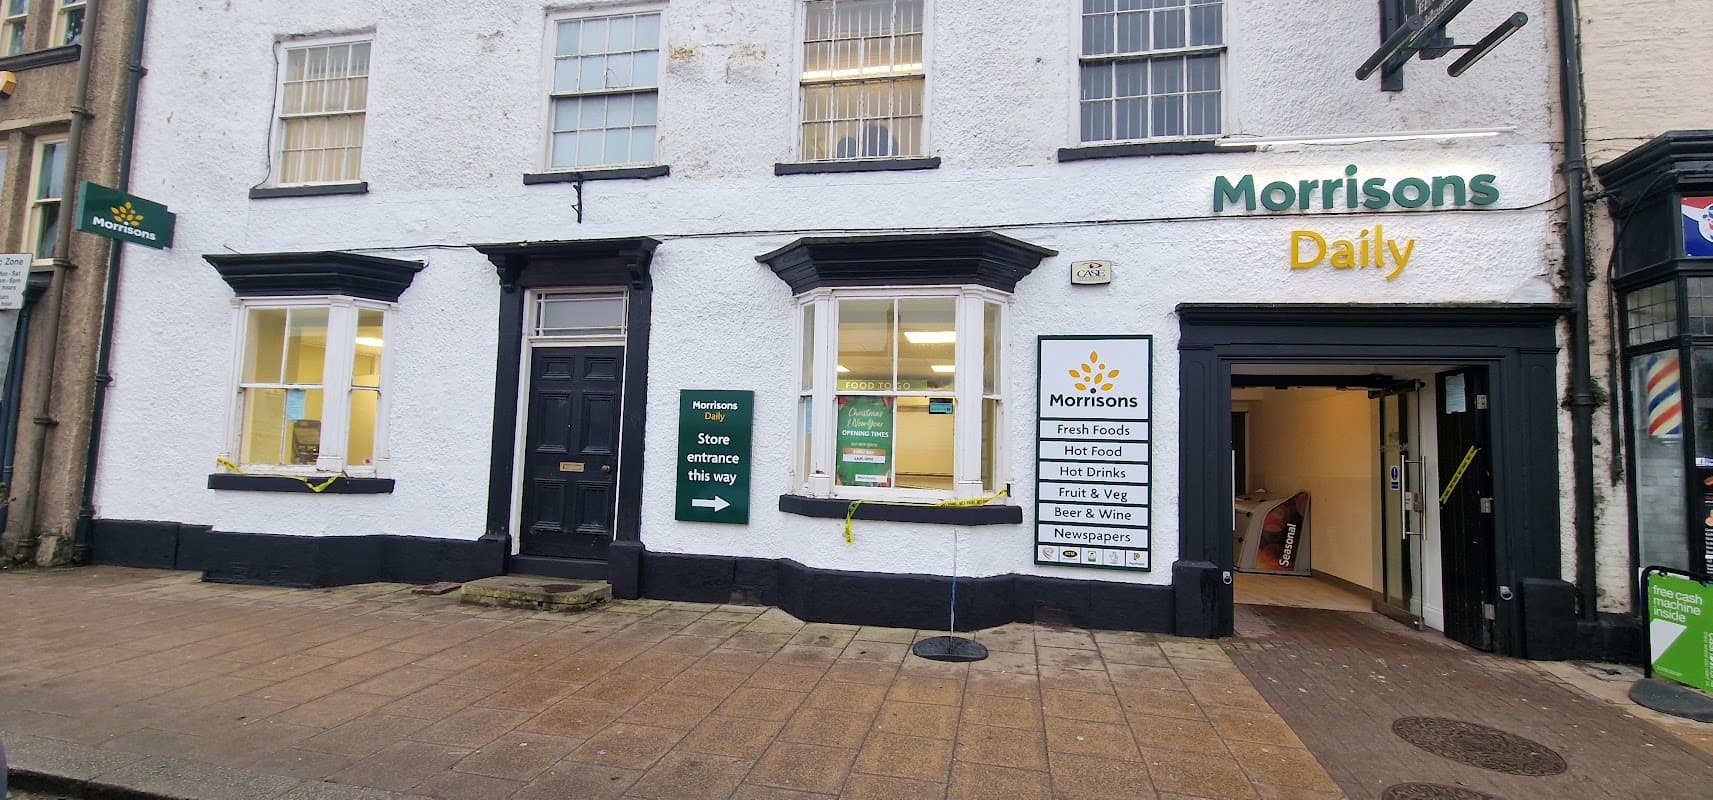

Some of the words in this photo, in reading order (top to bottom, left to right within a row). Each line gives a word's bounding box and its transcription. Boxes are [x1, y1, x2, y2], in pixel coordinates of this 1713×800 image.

[1213, 164, 1500, 212] Morrisons
[92, 216, 157, 241] Morrisons
[1290, 224, 1416, 281] Daily
[6, 257, 23, 266] Zone
[692, 401, 738, 410] Morrisons
[1050, 388, 1138, 408] Morrisons
[704, 411, 725, 422] Daily
[1057, 424, 1089, 435] Fresh
[1093, 424, 1130, 436] Foods
[697, 432, 730, 445] Store
[686, 452, 740, 464] entrance
[1064, 445, 1088, 456] Hot
[1091, 446, 1122, 457] Food
[687, 468, 711, 481] this
[713, 473, 737, 486] way
[1060, 466, 1083, 476] Hot
[1087, 467, 1126, 478] Drinks
[1059, 487, 1087, 498] Fruit
[1090, 489, 1099, 498] &
[1104, 489, 1128, 502] Veg
[1054, 507, 1082, 517] Beer
[1085, 508, 1095, 518] &
[1098, 509, 1132, 520] Wine
[1054, 528, 1131, 543] Newspapers
[1279, 522, 1297, 567] Seasonal
[1653, 585, 1674, 597] free
[1675, 592, 1703, 605] cash
[1653, 597, 1702, 616] machine
[1653, 607, 1686, 623] inside
